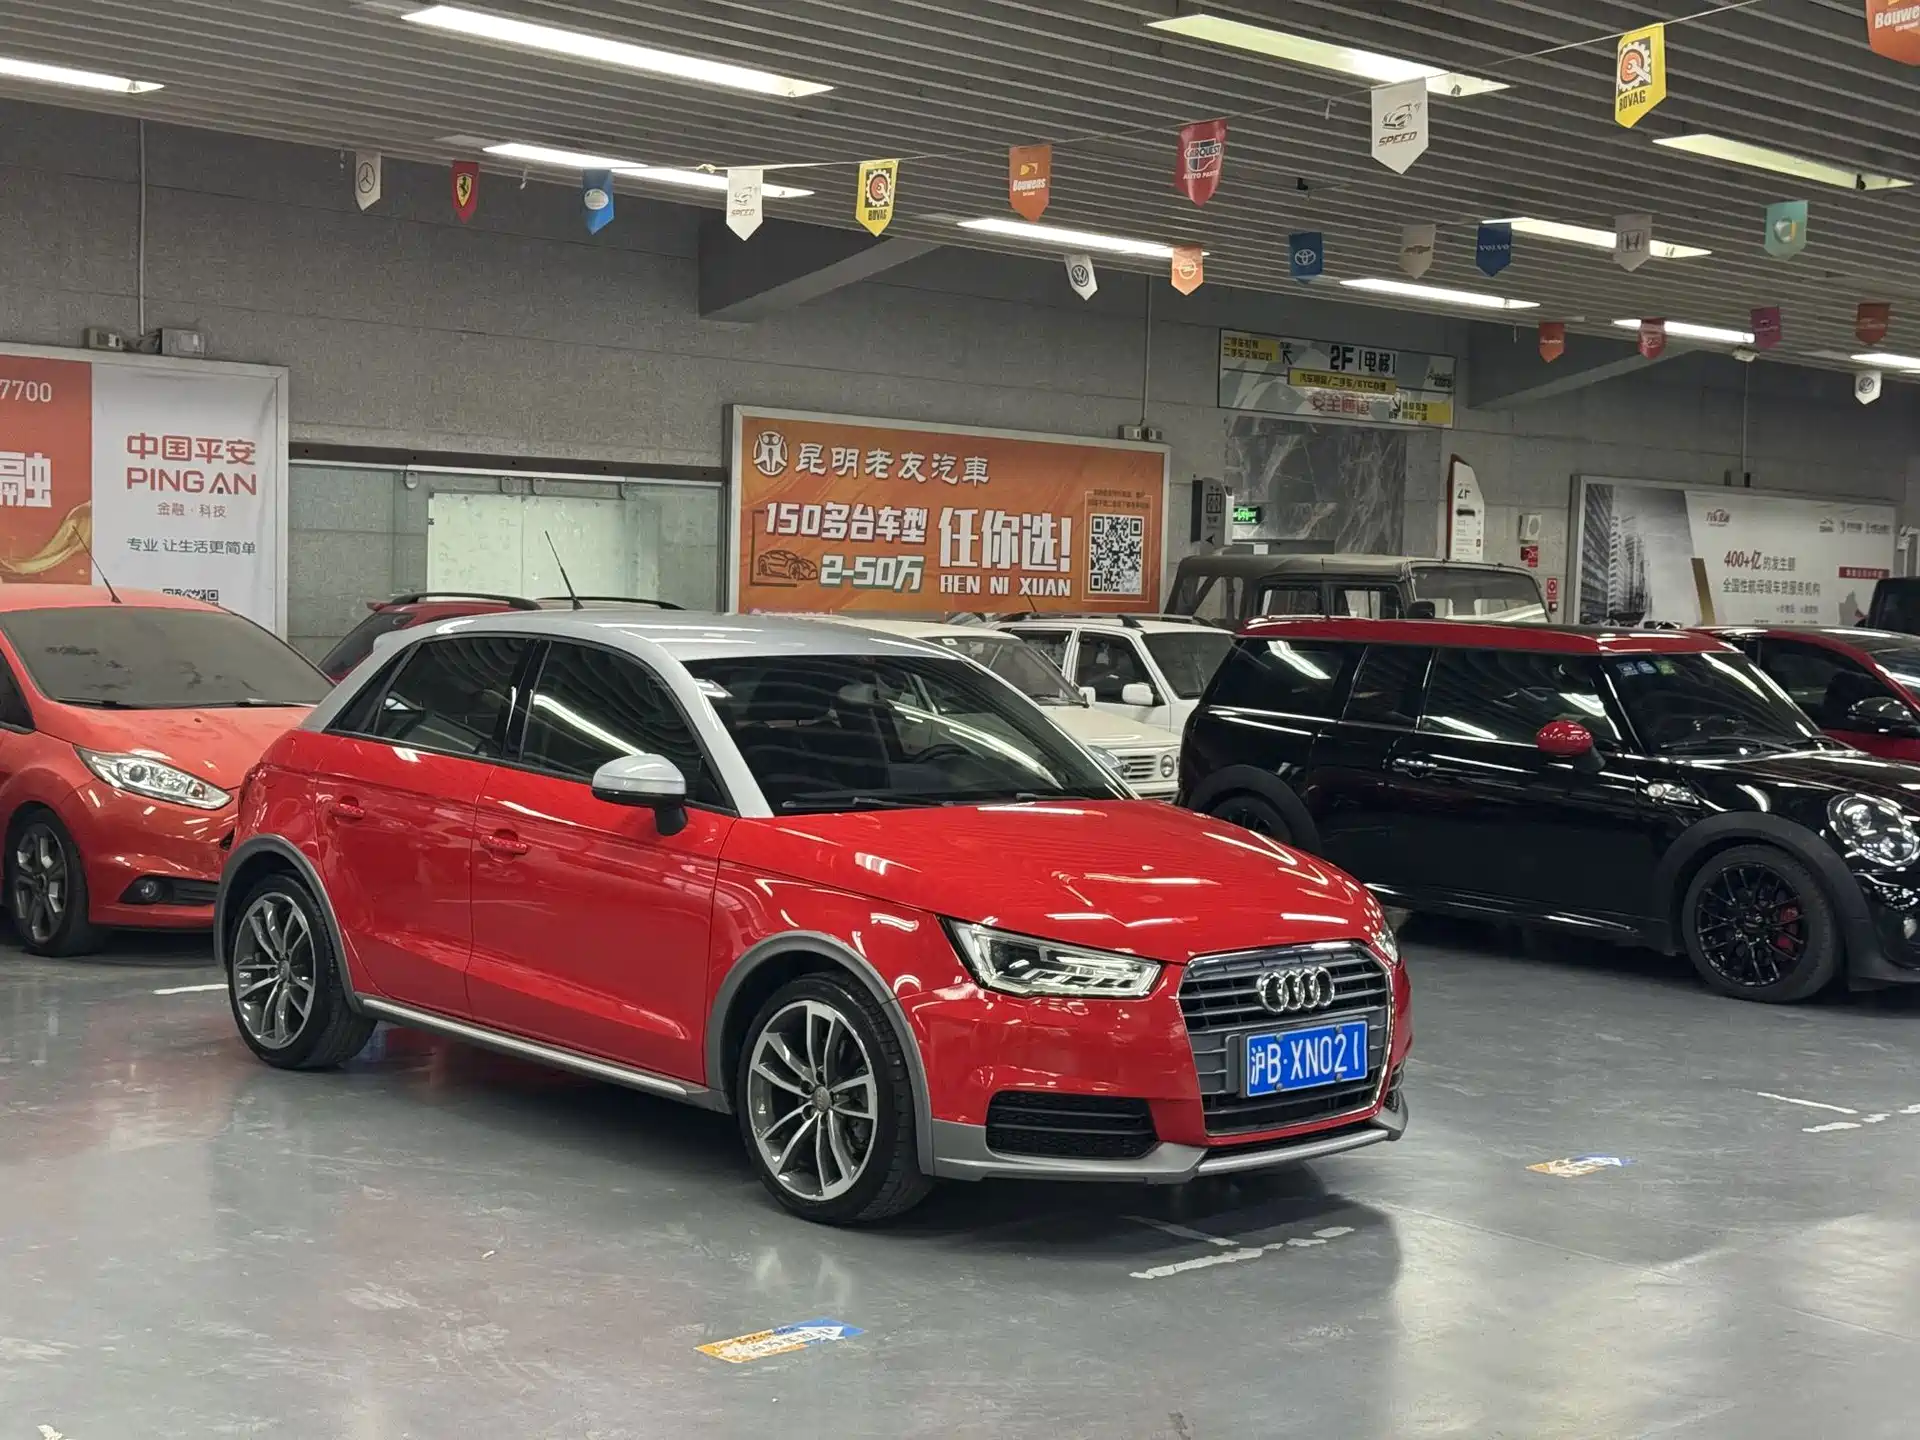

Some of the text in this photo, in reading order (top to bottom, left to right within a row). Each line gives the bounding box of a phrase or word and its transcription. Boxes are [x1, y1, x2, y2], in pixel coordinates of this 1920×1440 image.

[1619, 91, 1646, 111] BOVAG
[1378, 131, 1417, 146] SPEED
[1479, 244, 1510, 252] VOLVO
[1330, 344, 1354, 371] 2F
[126, 432, 256, 466] 中国平安
[766, 501, 929, 543] 150多台车型
[126, 537, 257, 556] 专业 让生活更简单
[820, 555, 925, 591] 2-50万
[940, 574, 1072, 597] REN NI XUAN
